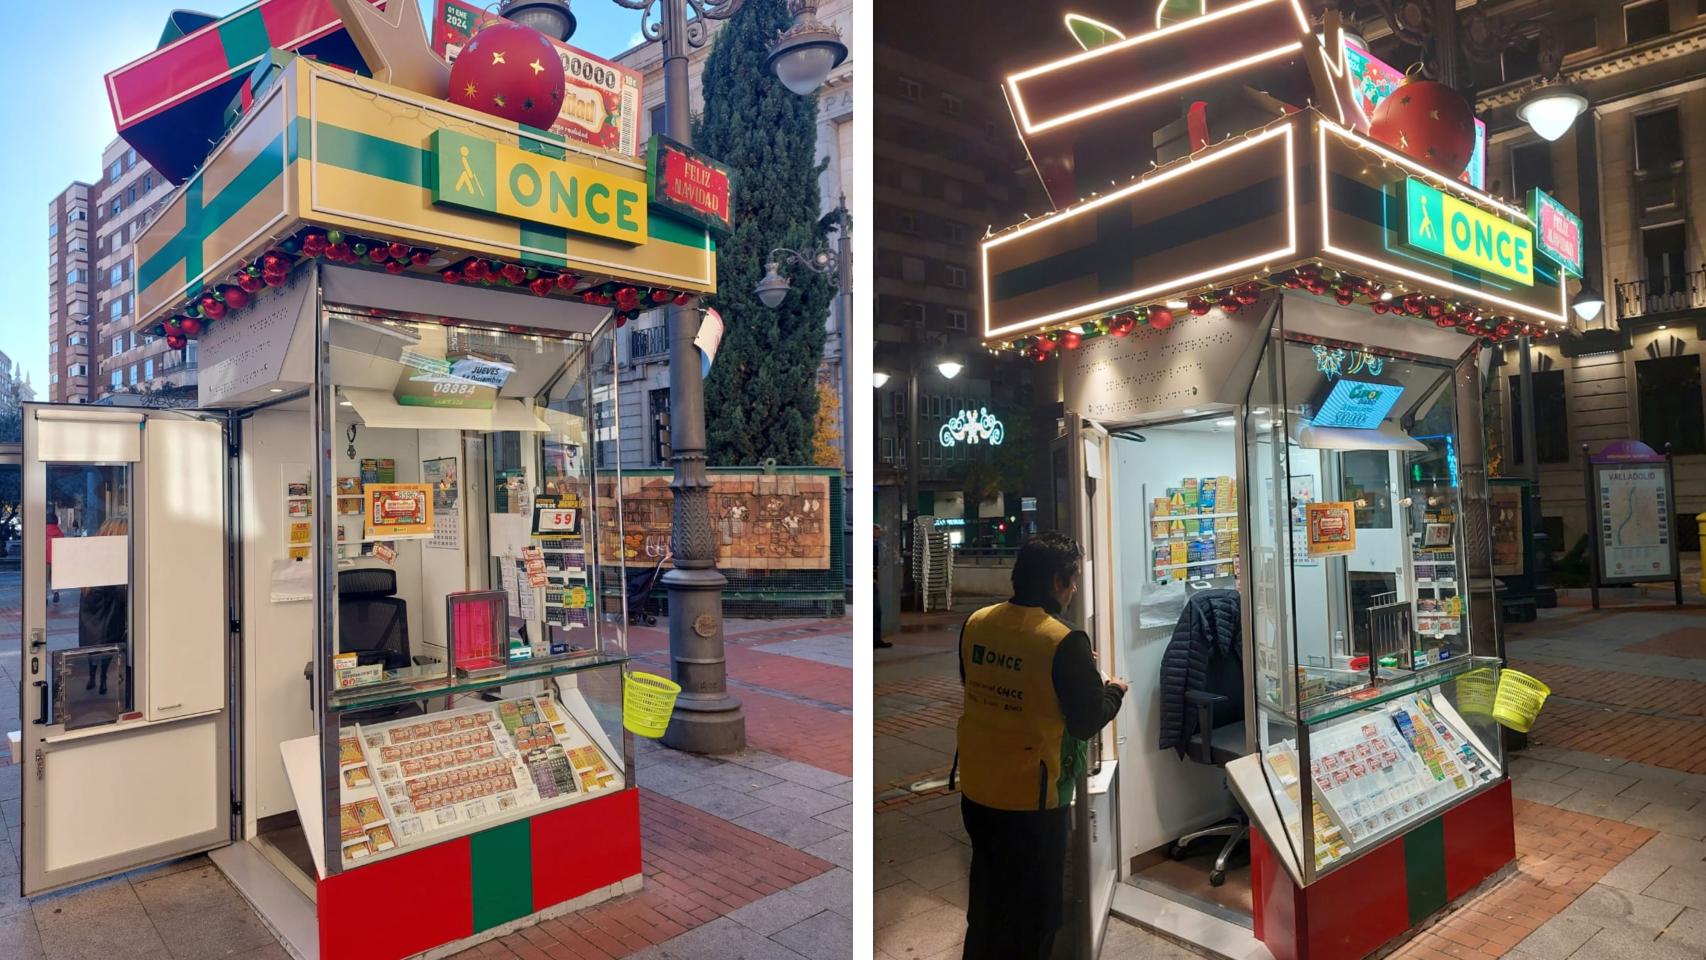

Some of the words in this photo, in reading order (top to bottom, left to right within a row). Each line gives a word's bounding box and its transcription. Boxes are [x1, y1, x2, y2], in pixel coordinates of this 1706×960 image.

[446, 14, 467, 30] 2024
[684, 161, 712, 189] FELIZ
[509, 163, 639, 232] ONCE
[674, 177, 719, 211] NAVIDAD
[1451, 211, 1528, 274] ONCE
[471, 365, 500, 376] JUEVES
[471, 373, 502, 385] Diciembre
[433, 382, 476, 395] 08884
[1608, 471, 1656, 481] VALLADOLID
[986, 651, 1022, 671] ONCE
